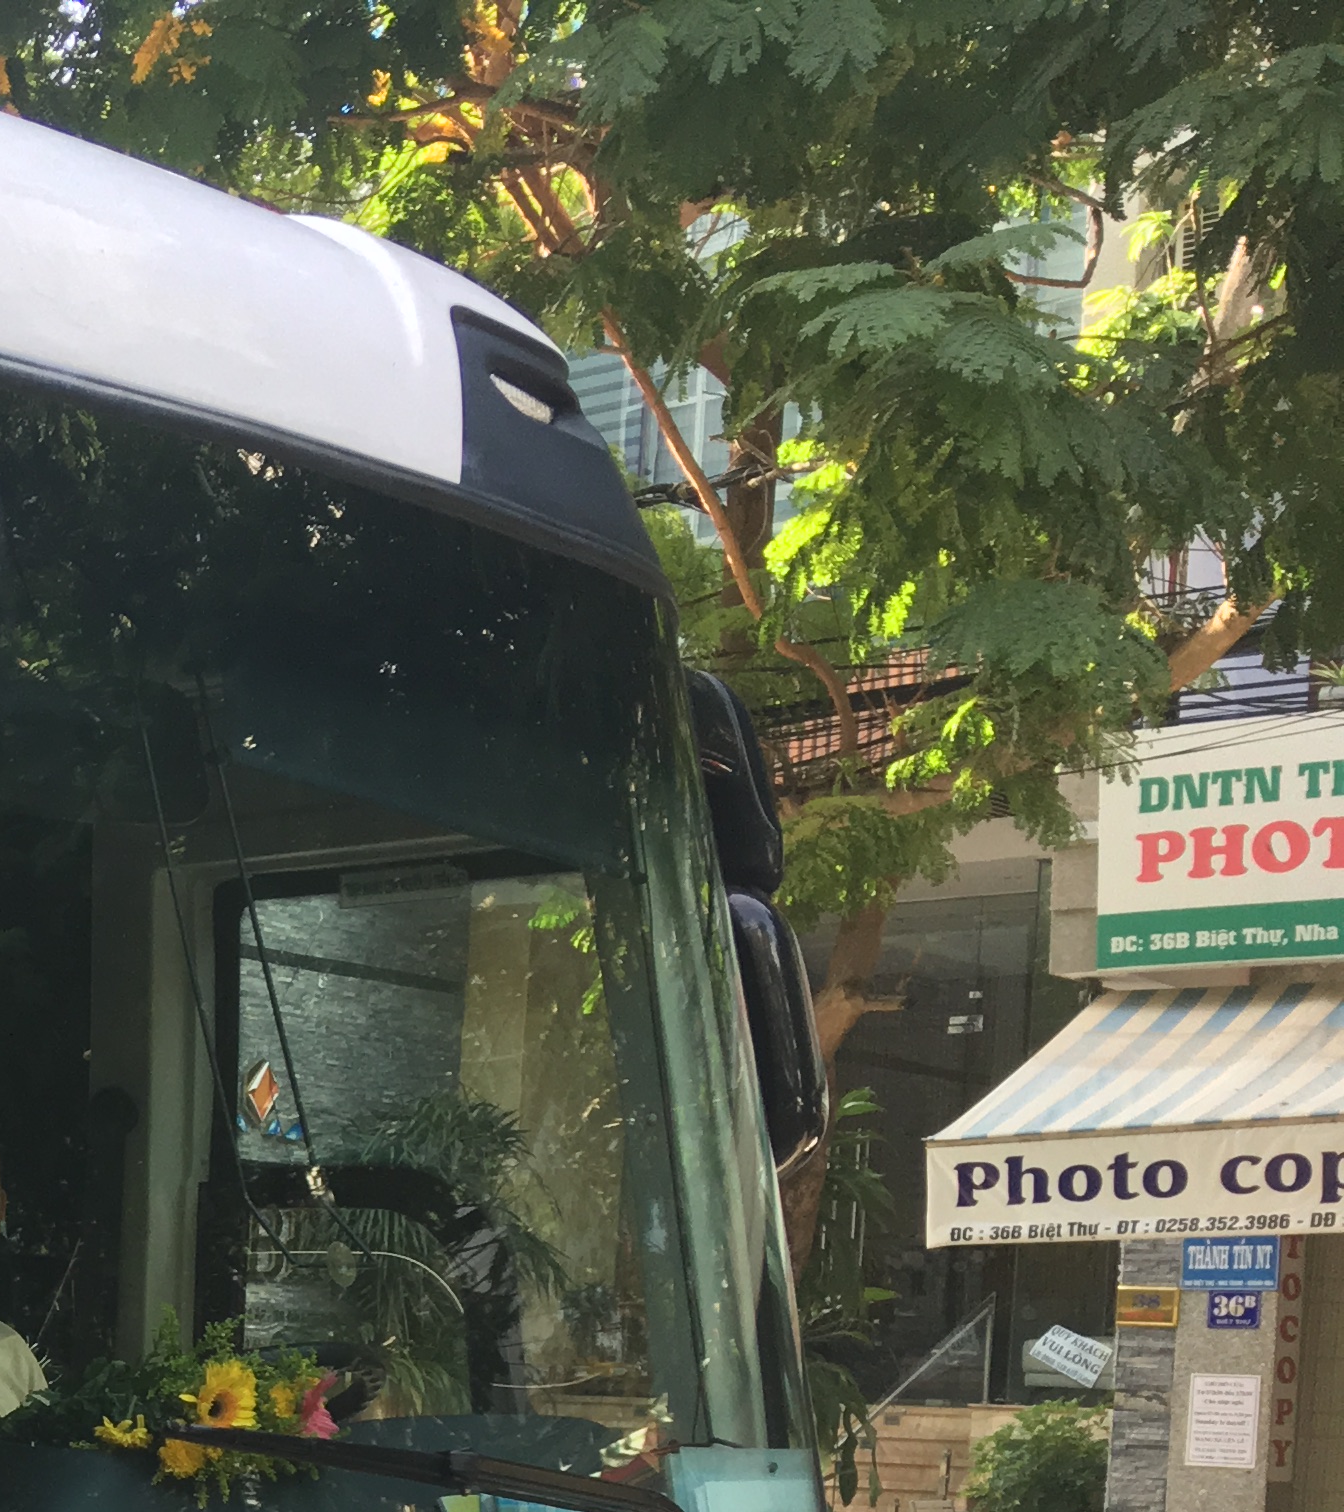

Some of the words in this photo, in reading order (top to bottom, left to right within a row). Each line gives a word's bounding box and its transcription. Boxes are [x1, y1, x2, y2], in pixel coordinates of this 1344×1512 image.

[1139, 764, 1282, 814] DNTN
[1110, 935, 1144, 953] ĐC:
[1150, 932, 1190, 950] 36B
[1196, 929, 1237, 949] Biệt
[1242, 927, 1289, 946] Thự,
[1295, 924, 1339, 942] Nha
[954, 1152, 1188, 1207] Photo
[989, 1225, 1022, 1241] 36B
[1155, 1213, 1291, 1233] 0258.352.3986
[1187, 1239, 1230, 1269] THÀNH
[1233, 1238, 1253, 1269] TÍN
[1255, 1245, 1273, 1269] NT
[1042, 1335, 1064, 1355] VUI
